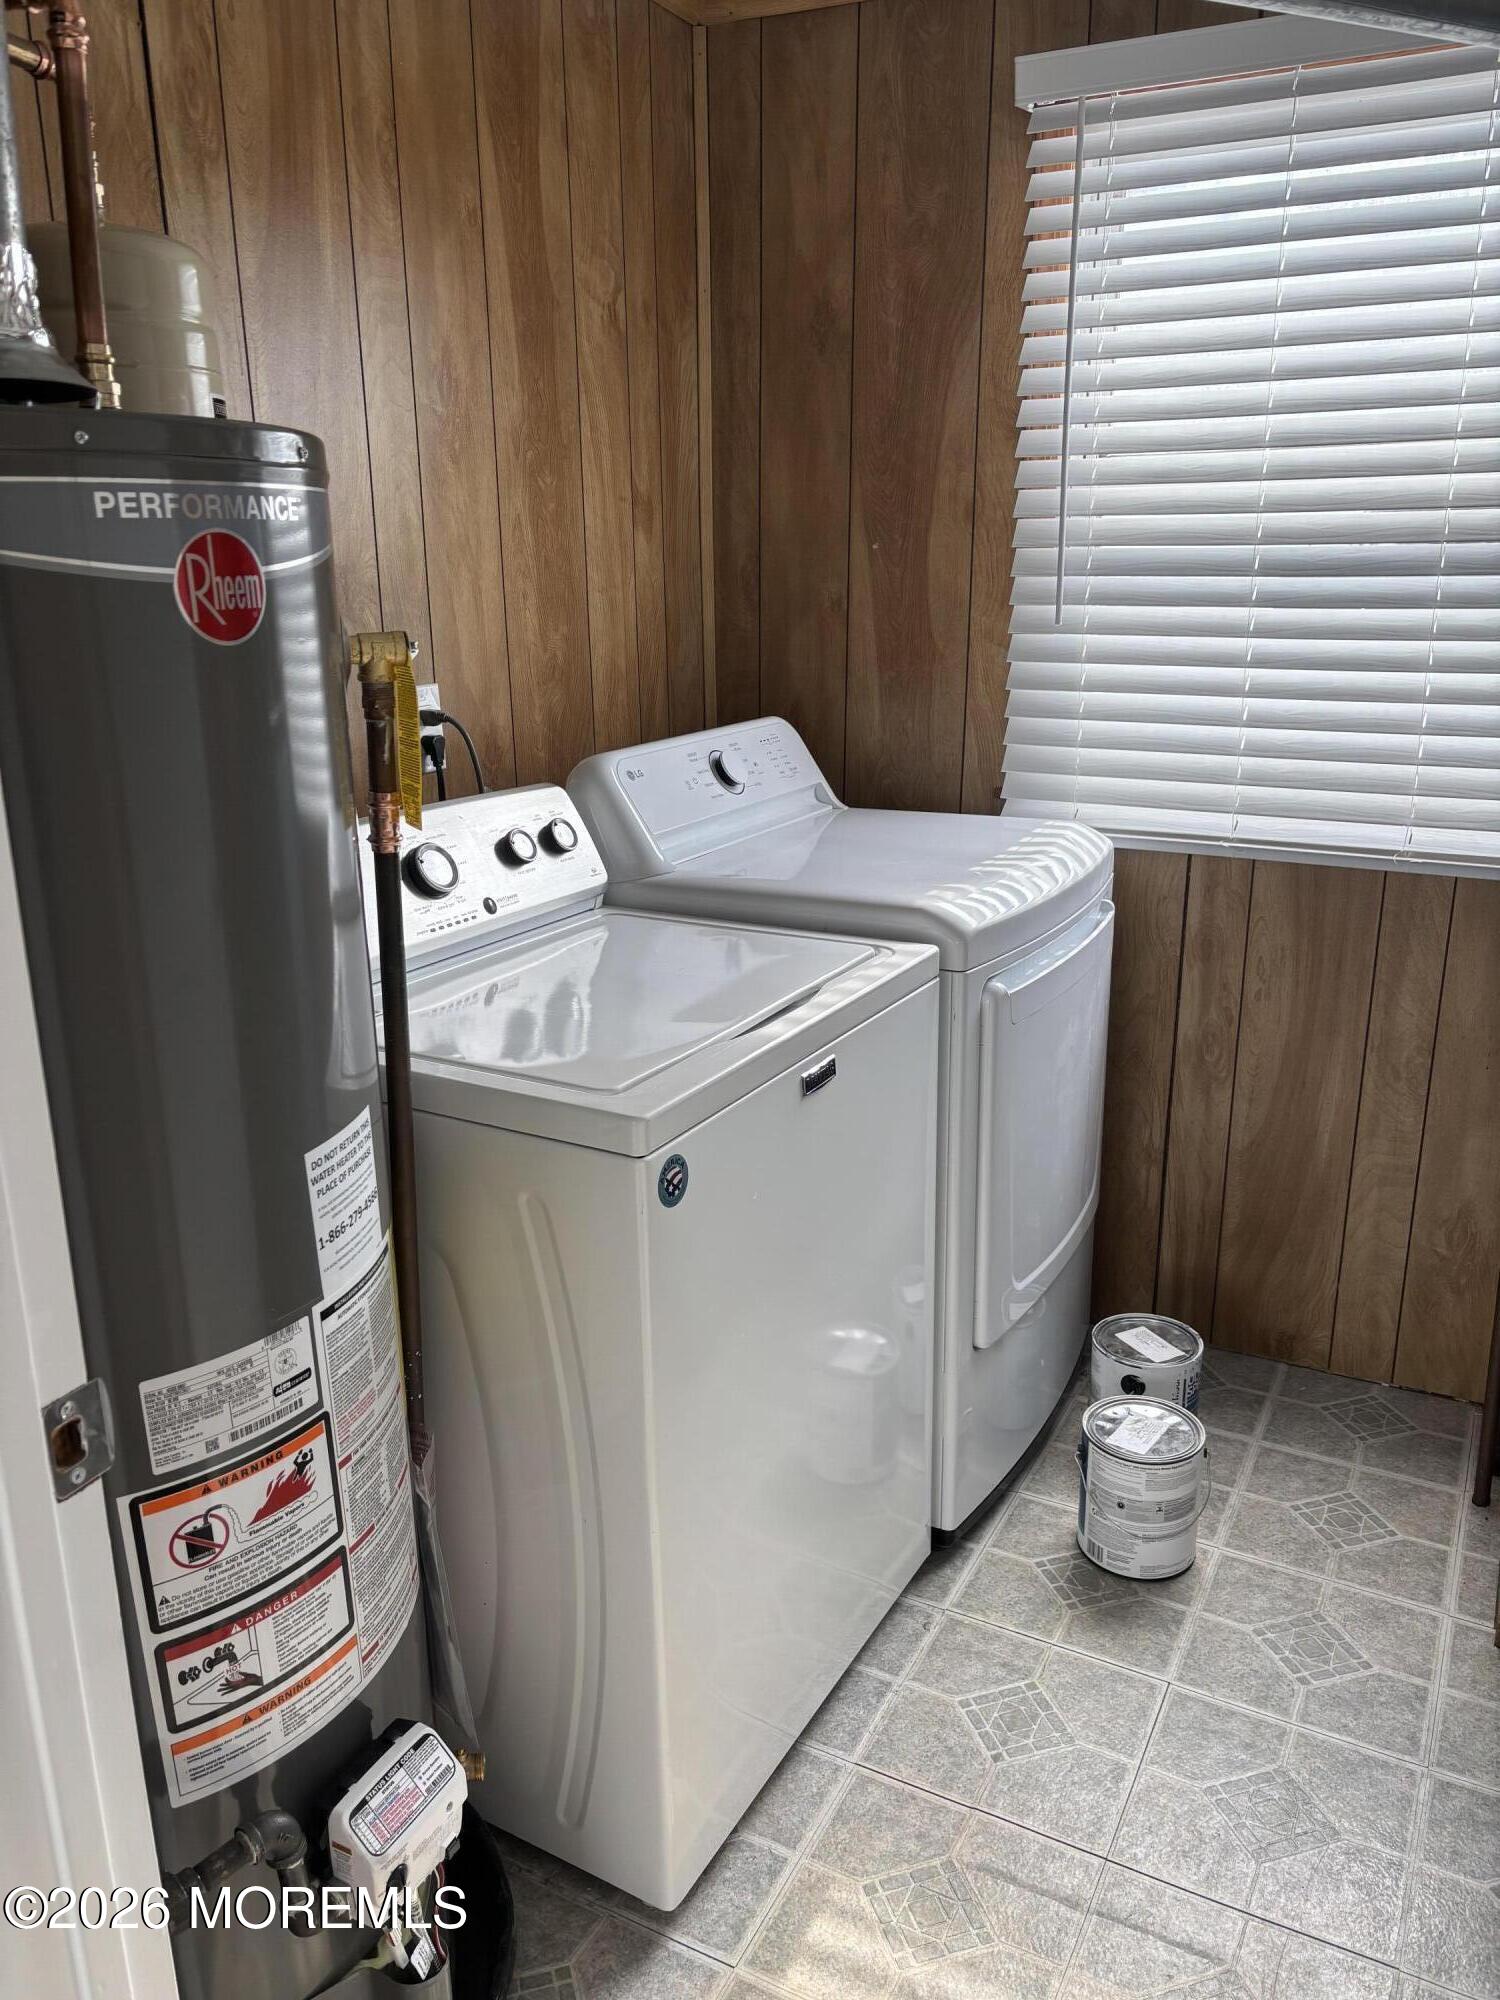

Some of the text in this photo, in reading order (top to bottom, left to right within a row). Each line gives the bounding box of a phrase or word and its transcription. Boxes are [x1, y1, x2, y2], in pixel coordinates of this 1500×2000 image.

[93, 491, 301, 522] PERFORMANCE
[185, 533, 262, 626] Rheem
[633, 769, 645, 778] LG
[310, 1164, 335, 1186] WATER
[336, 1147, 357, 1169] HEATER
[357, 1140, 364, 1151] TO
[311, 1157, 323, 1171] DO
[324, 1146, 339, 1163] NOT
[339, 1130, 360, 1152] RETURN
[316, 1178, 338, 1199] PLACE
[339, 1170, 347, 1183] OF
[347, 1146, 372, 1175] PURCHASE
[217, 1450, 284, 1488] WARNING
[249, 1502, 305, 1537] Flammable Vapors
[208, 1563, 223, 1572] FIRE
[225, 1555, 239, 1565] AND
[240, 1539, 274, 1558] EXPLOSION
[275, 1524, 298, 1540] HAZARD
[204, 1573, 217, 1581] Can
[218, 1564, 236, 1575] result
[245, 1590, 299, 1626] DANGER
[226, 1662, 241, 1674] HOT
[259, 1676, 312, 1715] WARNING
[365, 1748, 415, 1801] STATUS LIGHT CODE
